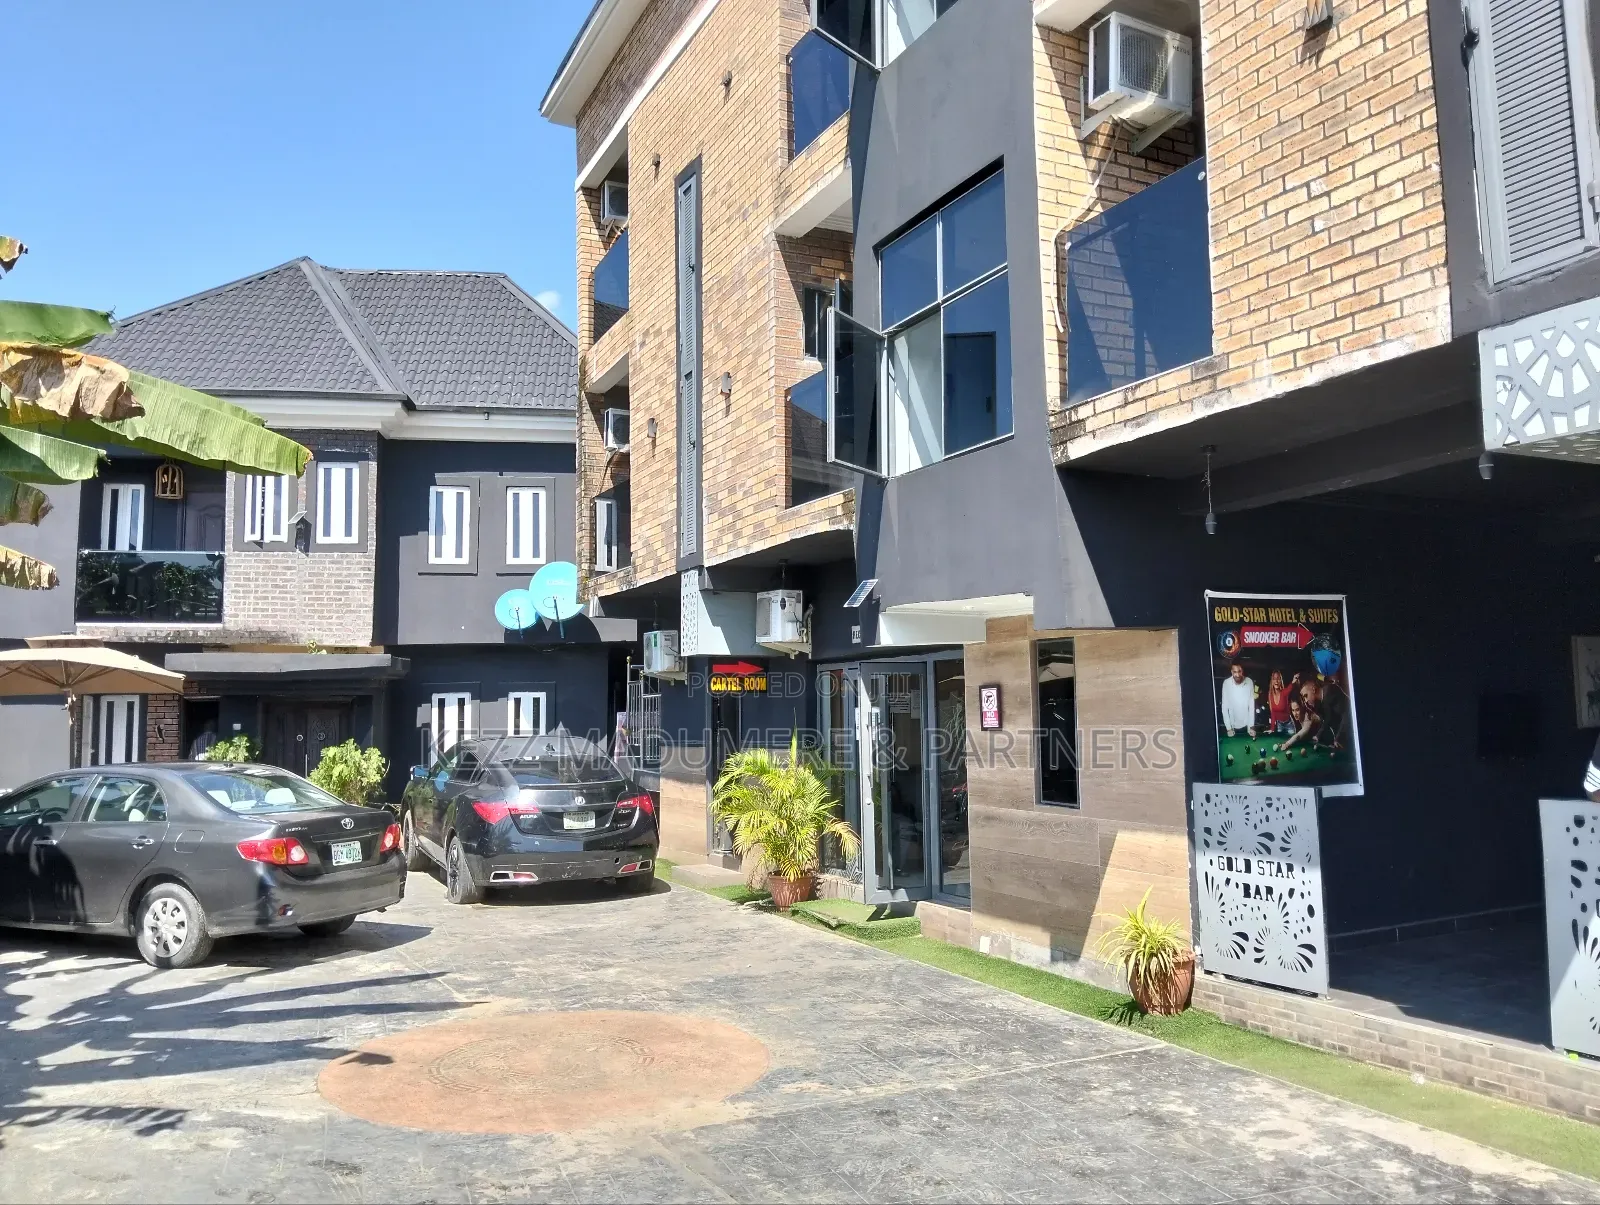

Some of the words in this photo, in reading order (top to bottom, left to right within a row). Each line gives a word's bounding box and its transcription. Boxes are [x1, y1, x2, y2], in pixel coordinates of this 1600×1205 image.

[1214, 606, 1267, 623] GOLD-STAR
[1268, 607, 1298, 623] HOTEL
[1300, 609, 1307, 623] &
[1307, 608, 1339, 624] SUITES
[1243, 631, 1279, 644] SNOOKER
[1281, 632, 1297, 644] BAR
[711, 677, 742, 692] CARTEL
[744, 676, 767, 691] ROOM
[1217, 856, 1252, 874] GOLD
[1257, 860, 1295, 879] STAR
[1242, 882, 1275, 902] BAR
